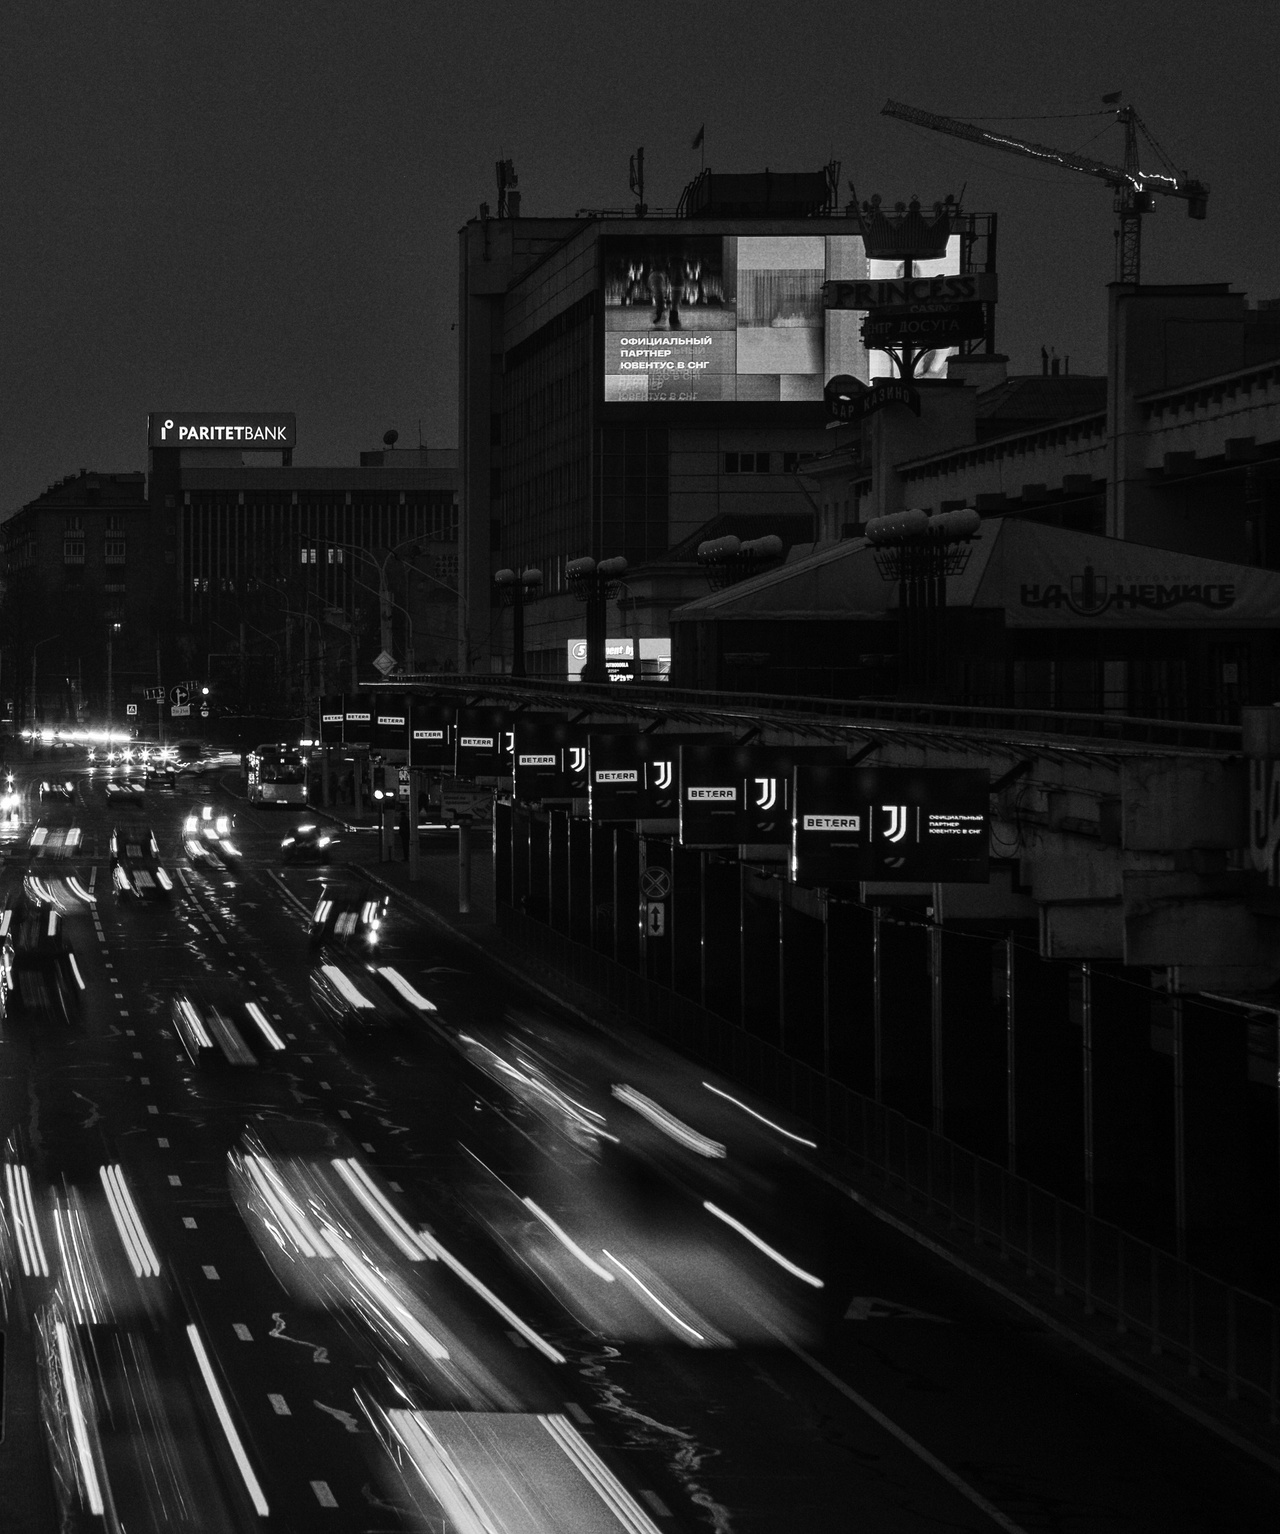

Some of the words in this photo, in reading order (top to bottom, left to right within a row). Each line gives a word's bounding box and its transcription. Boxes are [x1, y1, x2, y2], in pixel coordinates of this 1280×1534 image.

[834, 276, 976, 307] PRINCESS
[909, 303, 960, 314] CASINO
[899, 319, 960, 333] ДОСУГА
[620, 335, 713, 347] ОФИЦИАЛЬНЫЙ
[620, 349, 672, 358] ПАРТНЕР
[620, 361, 675, 370] ЮВЕНТУС
[677, 361, 685, 369] В
[687, 361, 711, 369] СНГ
[831, 401, 855, 419] БАР
[863, 386, 910, 412] КАЗИНО
[178, 425, 288, 441] PARITETBANK
[1020, 583, 1063, 609] НА
[929, 813, 984, 821] ОФИЦИАЛЬНЫЙ
